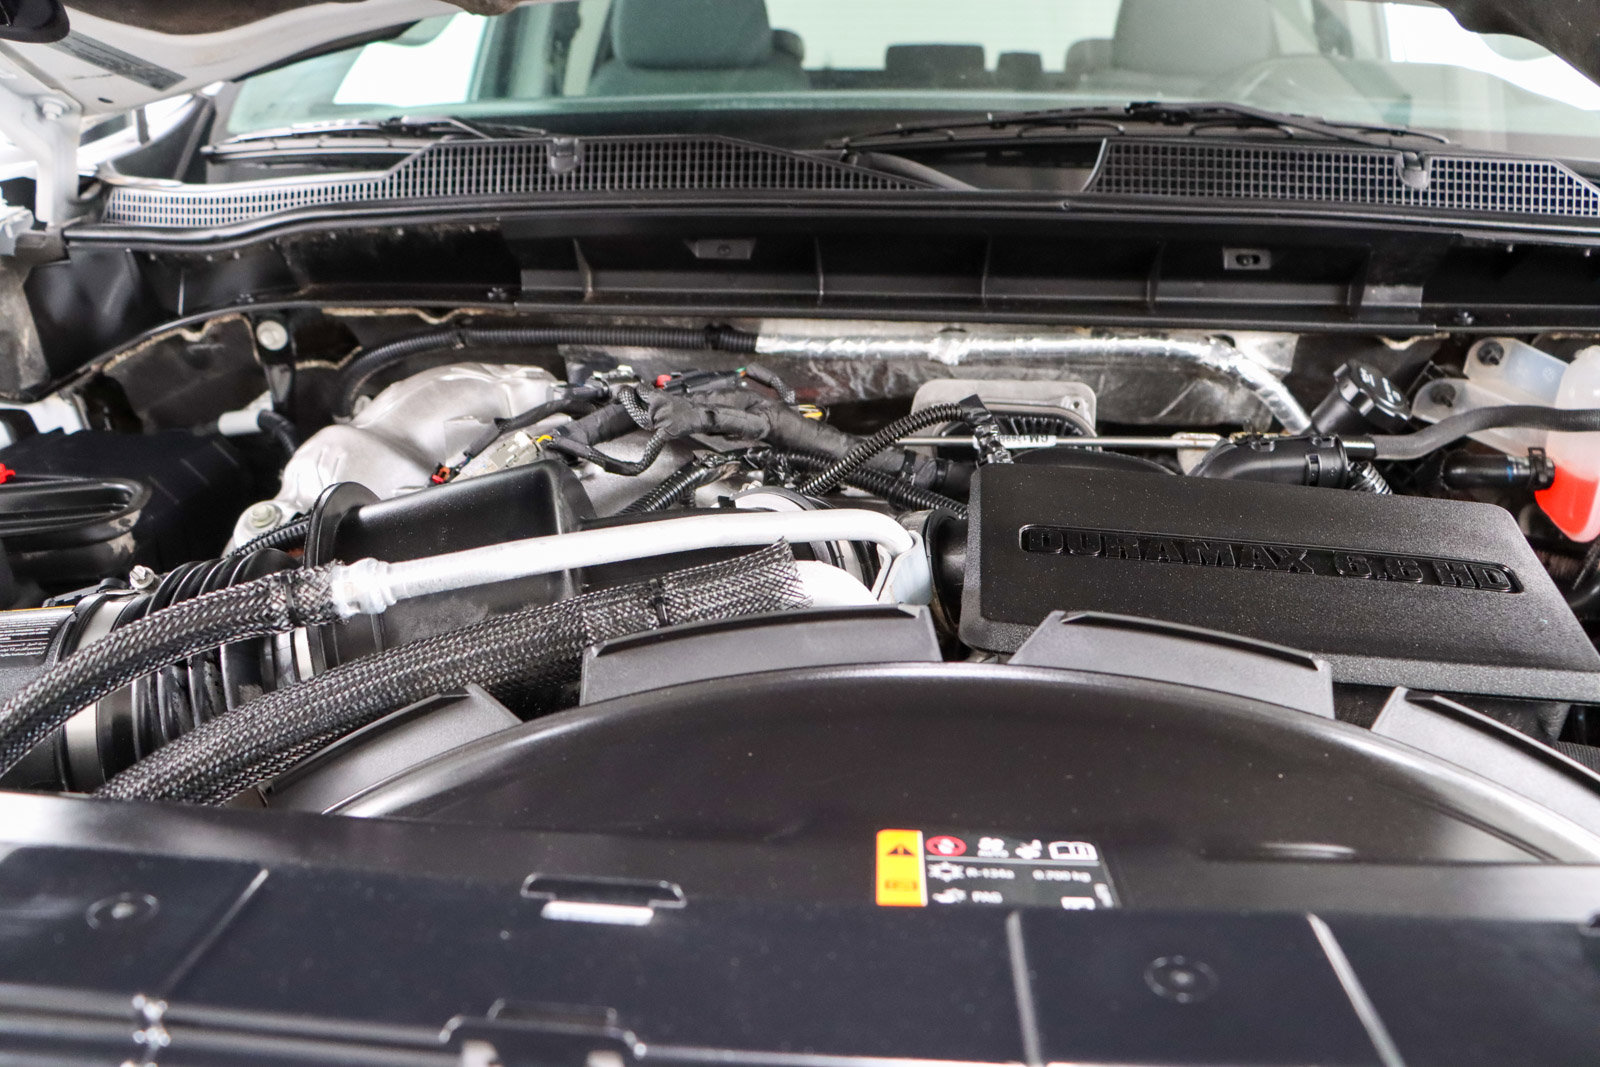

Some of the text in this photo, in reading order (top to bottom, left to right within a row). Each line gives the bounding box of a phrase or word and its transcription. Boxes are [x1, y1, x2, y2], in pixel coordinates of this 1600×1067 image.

[1027, 529, 1512, 592] DURAMAX 6.6 HD
